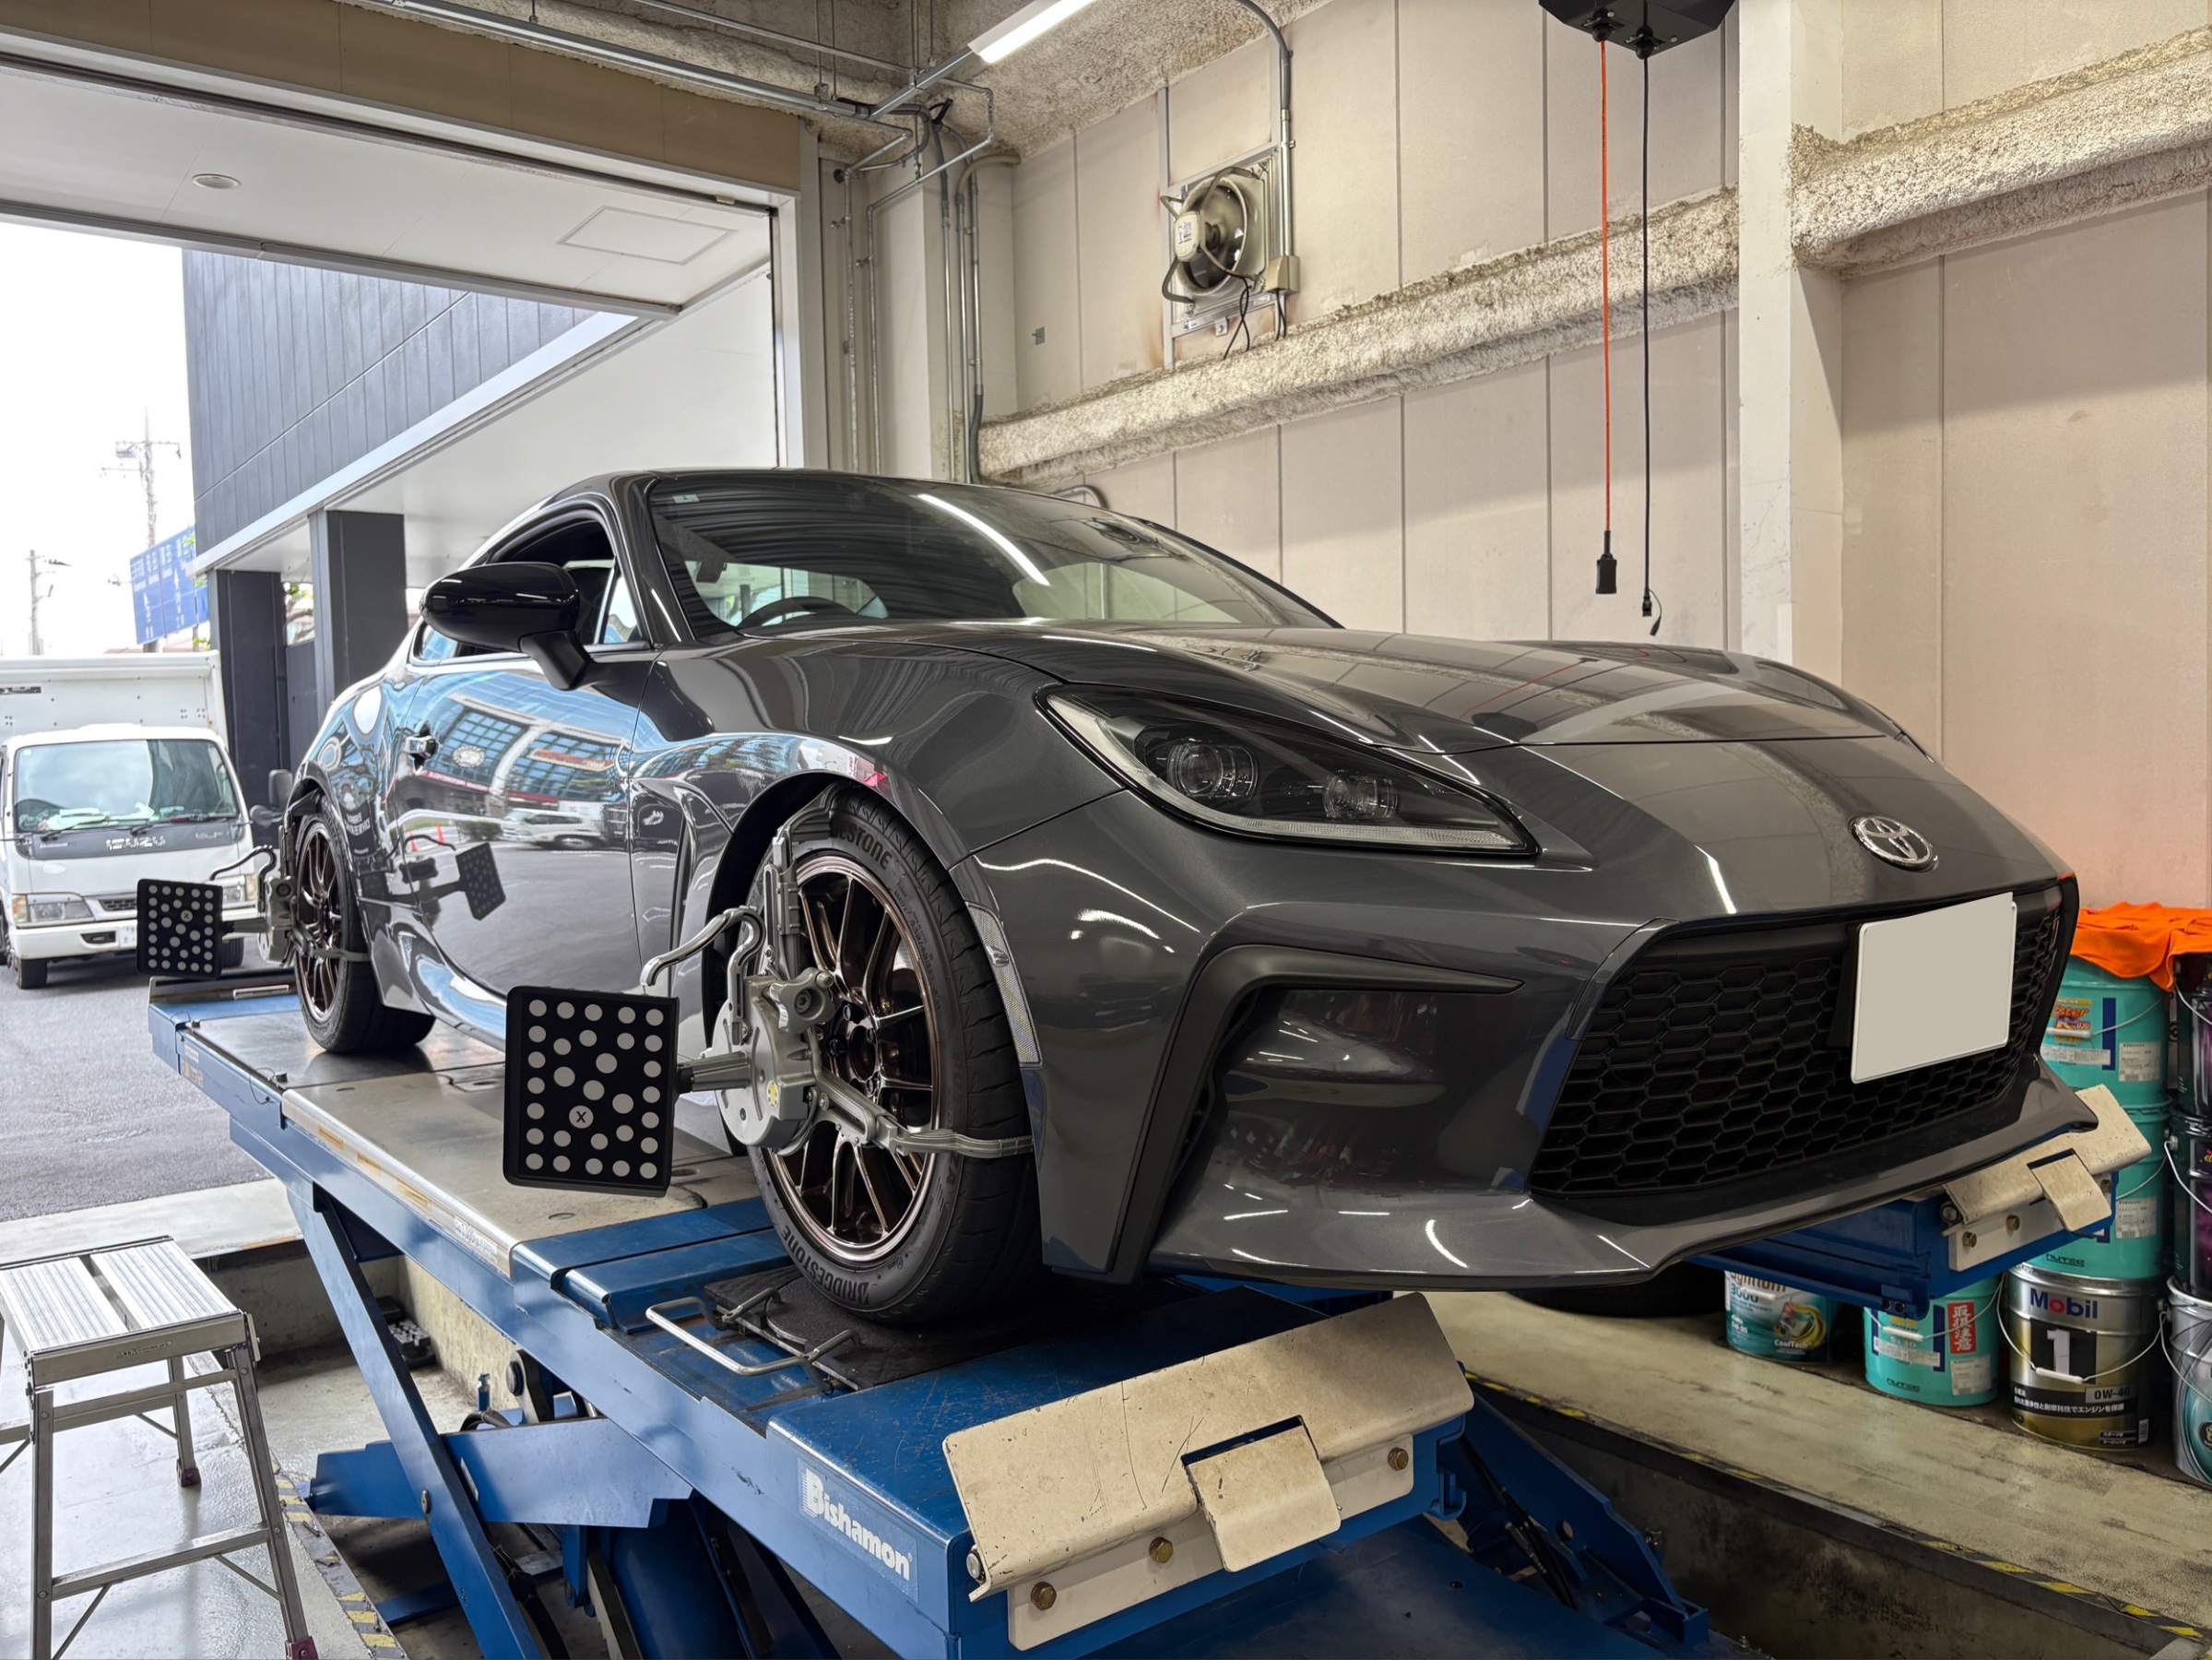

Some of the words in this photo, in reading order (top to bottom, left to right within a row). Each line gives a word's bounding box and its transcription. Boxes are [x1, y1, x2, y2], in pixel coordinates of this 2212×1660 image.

[105, 836, 167, 851] ISUZU
[782, 1224, 870, 1306] BRIDGESTONE
[2029, 1287, 2098, 1320] Mobil
[1773, 1338, 1809, 1350] CoolTech
[2046, 1328, 2071, 1375] 1
[2094, 1386, 2131, 1400] 0W-40
[801, 1468, 911, 1582] Bishamon
